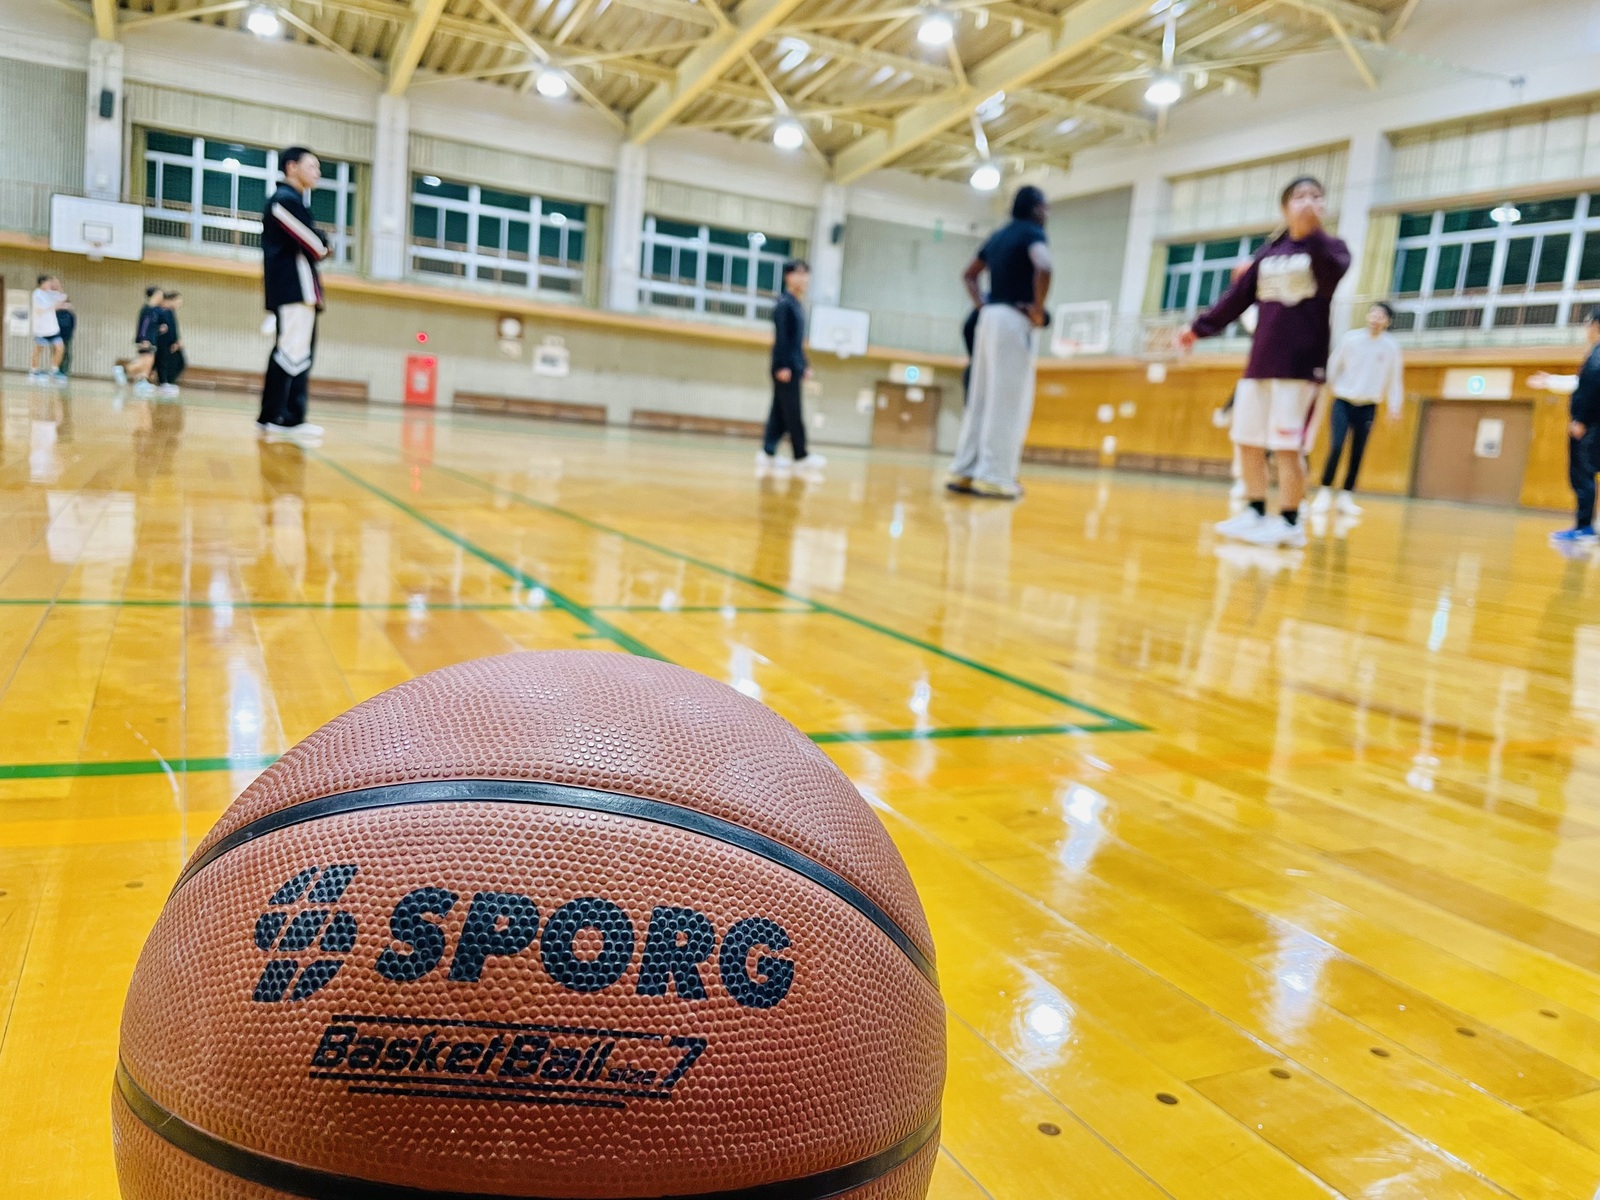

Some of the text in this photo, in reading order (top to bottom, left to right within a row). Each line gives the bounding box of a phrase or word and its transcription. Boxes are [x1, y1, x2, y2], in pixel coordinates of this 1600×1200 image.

[374, 886, 796, 1009] SPORG
[310, 1026, 616, 1082] BasketBall
[658, 1037, 708, 1088] 7
